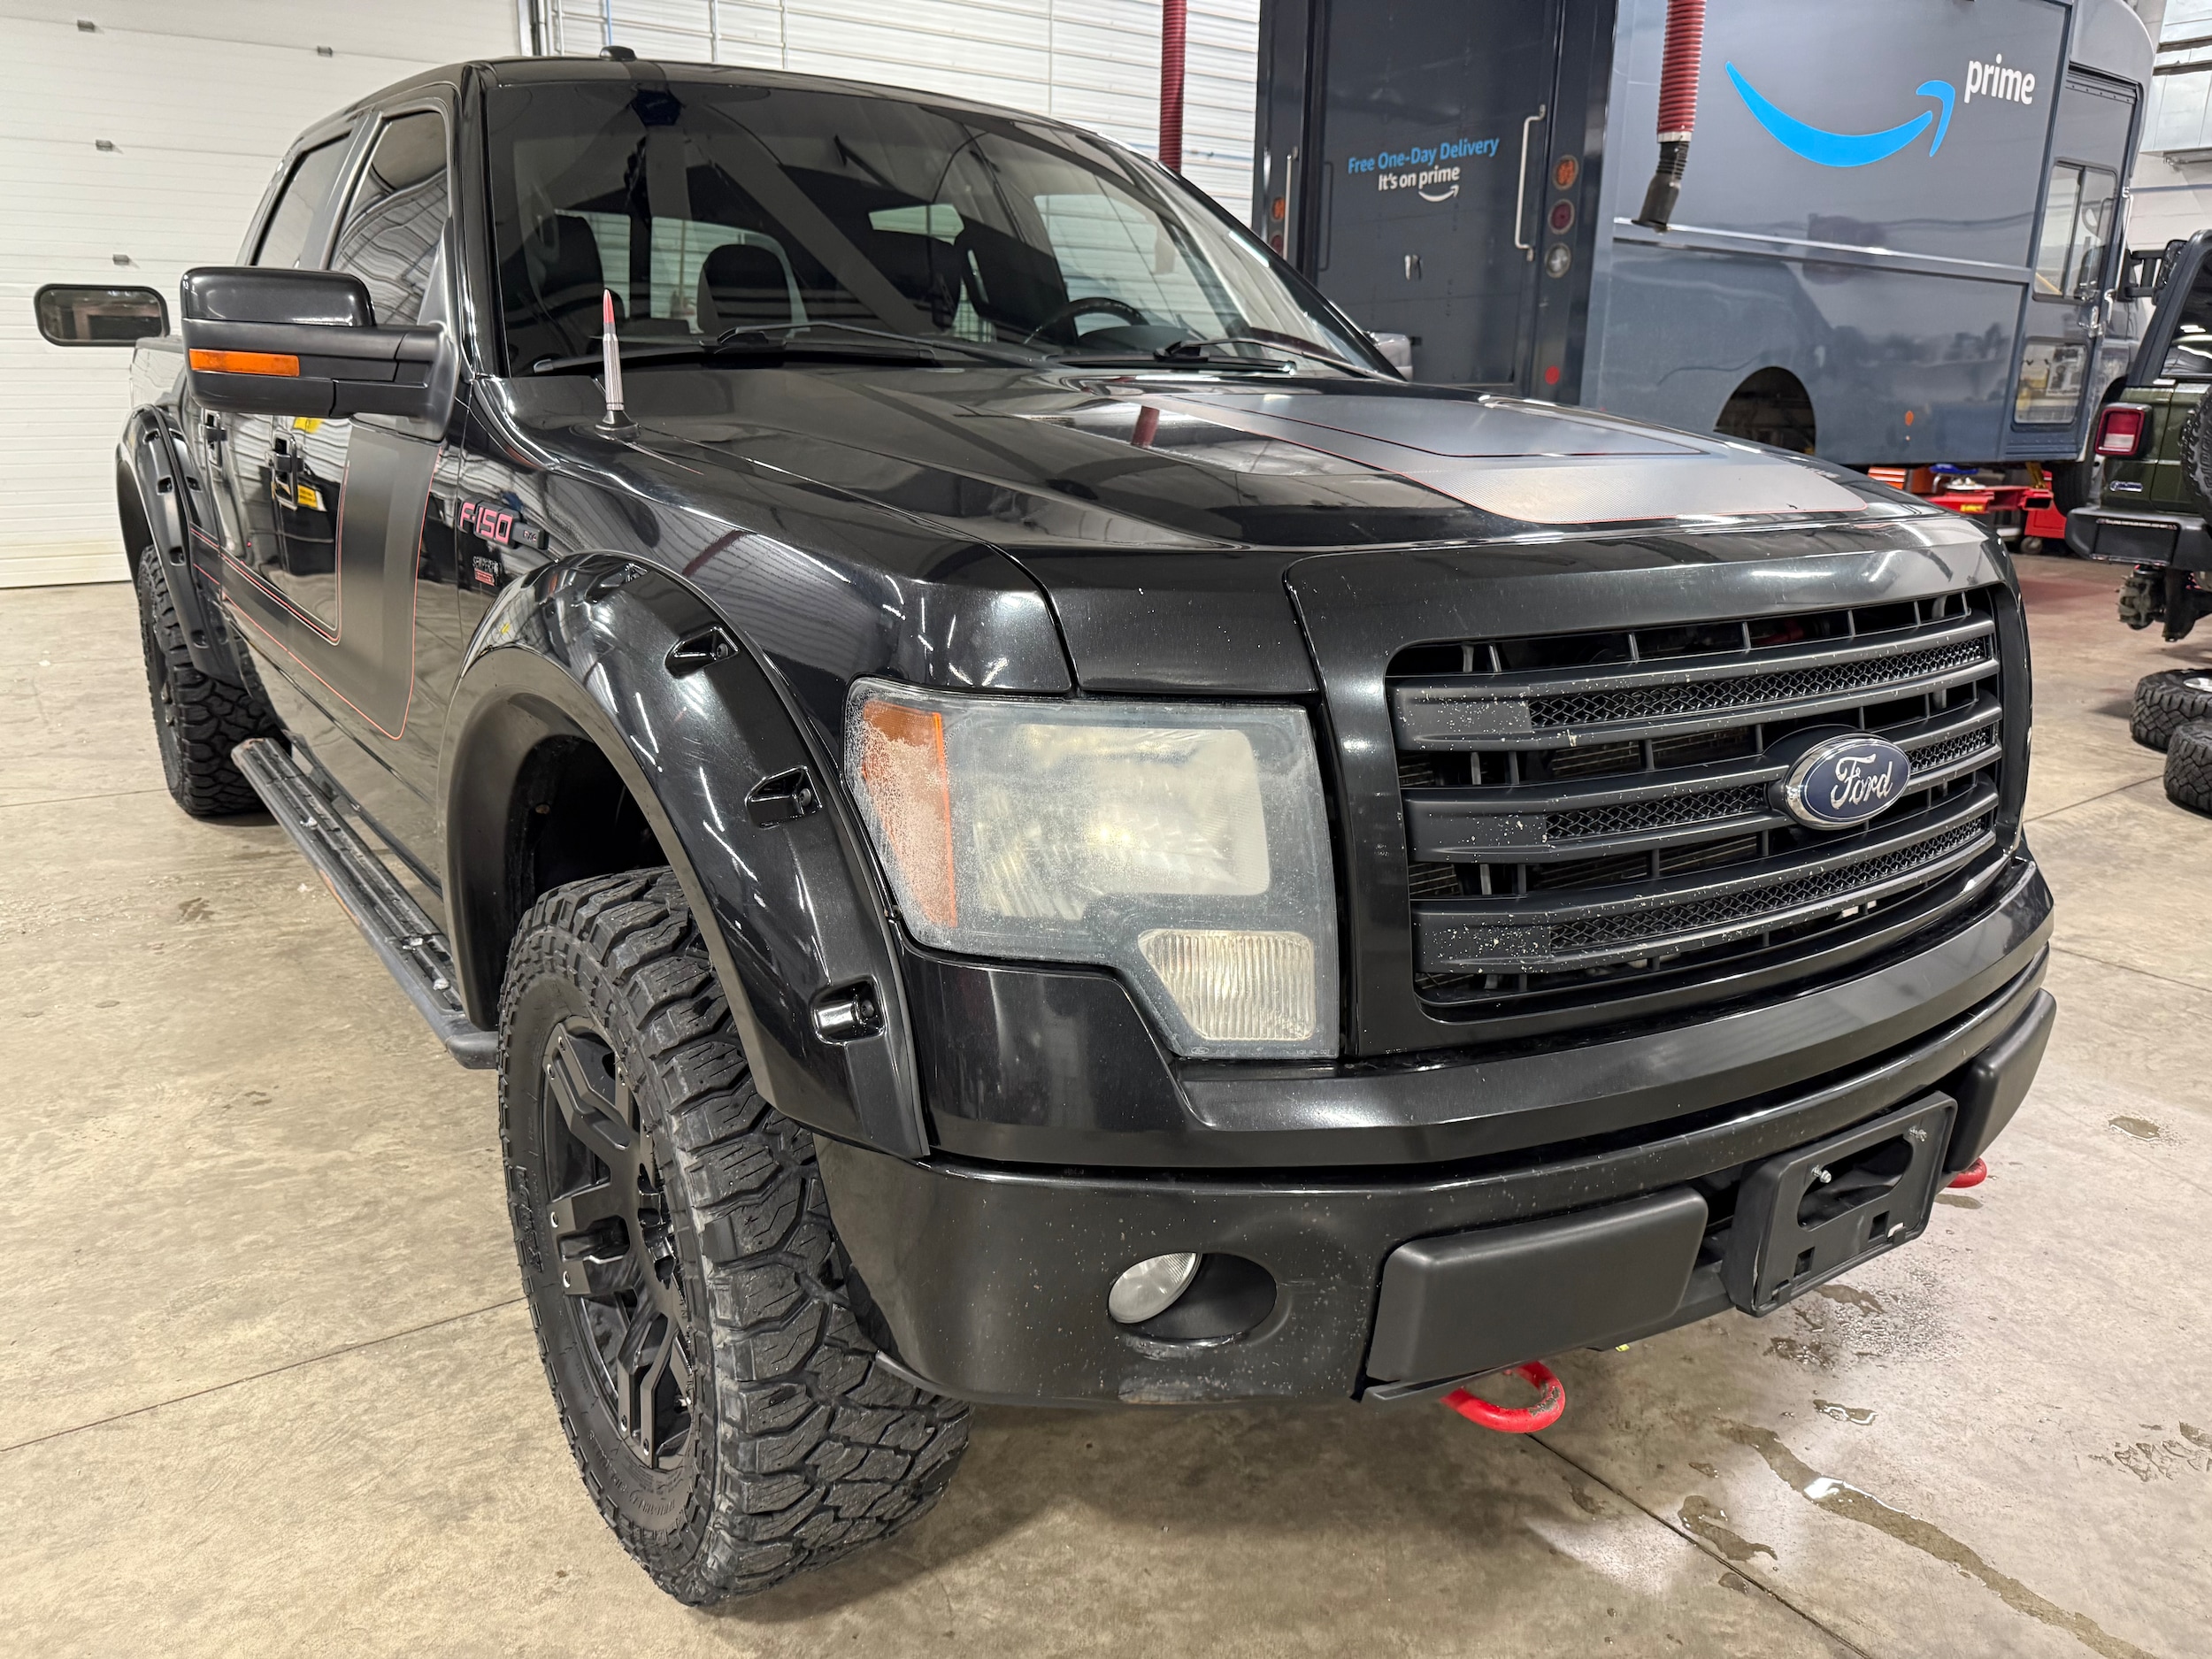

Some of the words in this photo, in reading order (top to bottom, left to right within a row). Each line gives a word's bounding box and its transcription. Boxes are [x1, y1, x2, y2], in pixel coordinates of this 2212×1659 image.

[1964, 53, 2035, 104] prime
[1348, 157, 1375, 173] Free
[1378, 147, 1437, 170] One-Day
[1440, 137, 1500, 160] Delivery
[1378, 173, 1398, 191] It's
[1399, 174, 1417, 188] on
[1418, 165, 1460, 189] prime
[460, 502, 513, 545] F-150
[1830, 753, 1893, 810] Ford
